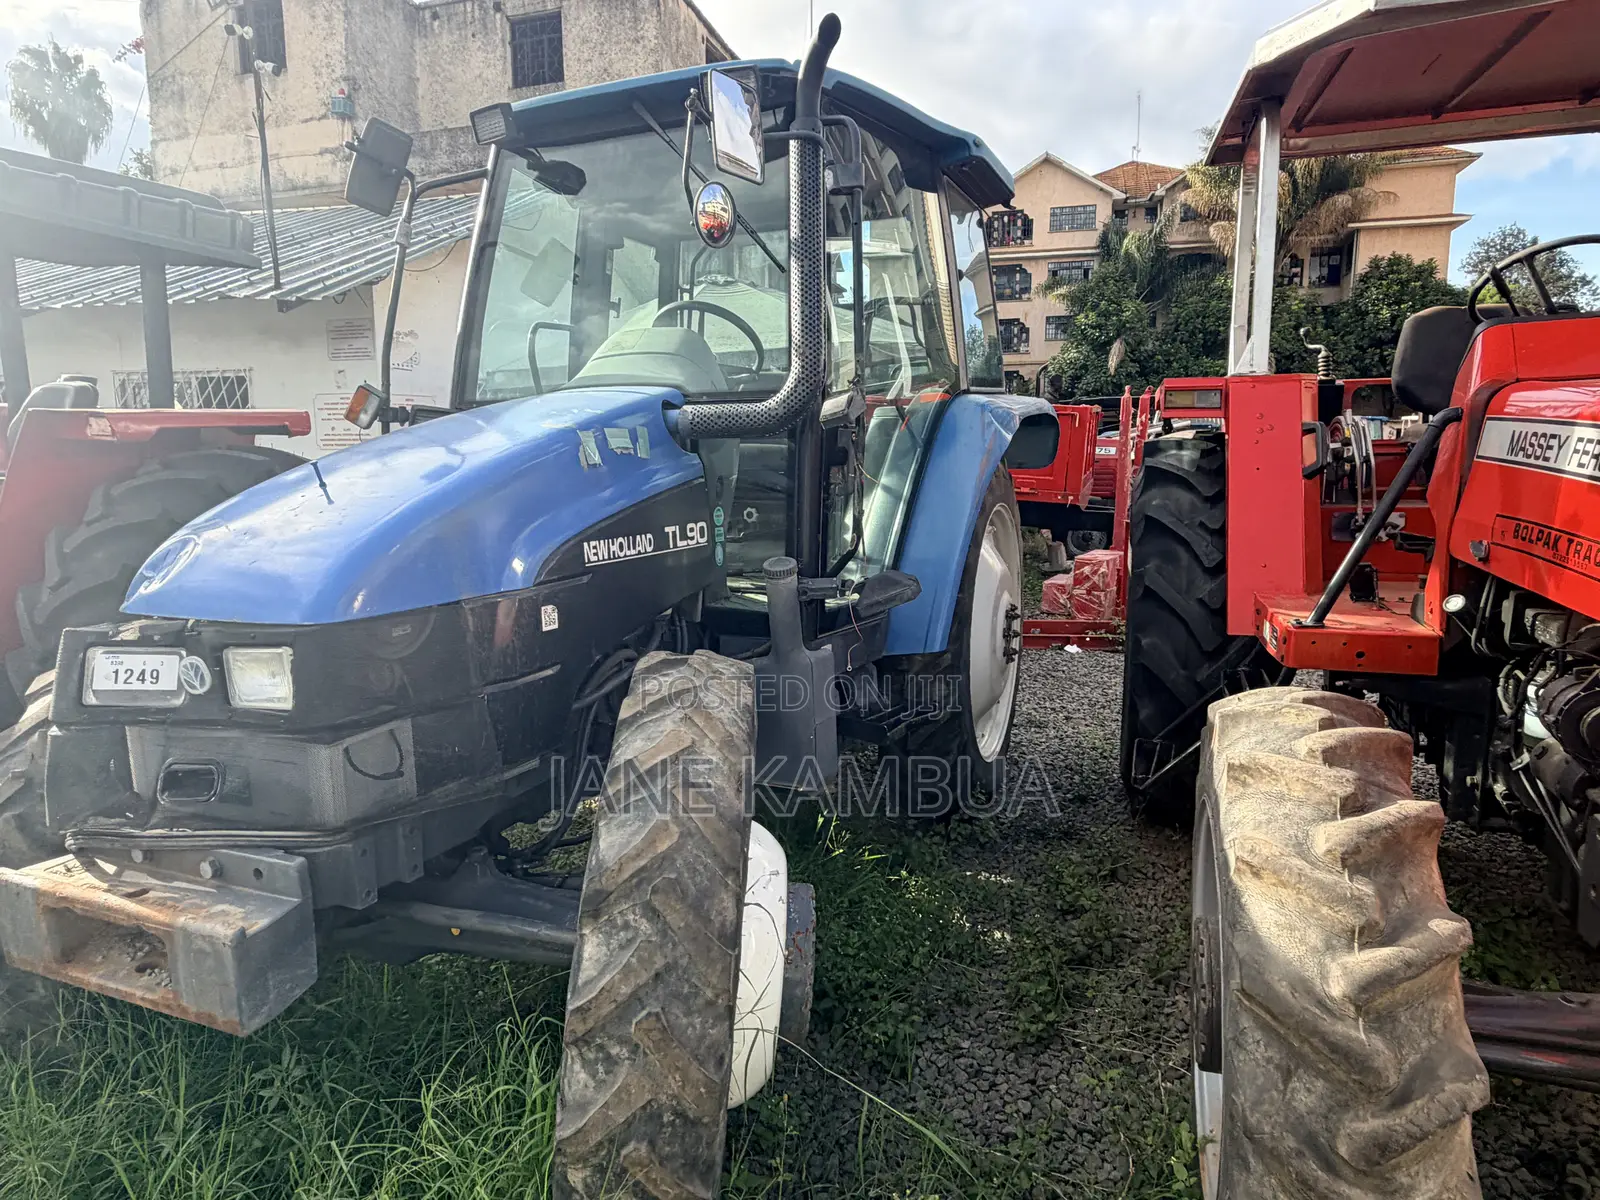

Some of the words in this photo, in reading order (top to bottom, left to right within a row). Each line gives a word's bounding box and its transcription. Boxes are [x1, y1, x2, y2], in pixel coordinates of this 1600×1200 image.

[1506, 429, 1570, 464] MASSEY
[1567, 436, 1600, 473] FER
[664, 521, 708, 549] TL90
[1513, 523, 1562, 553] BOLPAK
[112, 668, 160, 685] 1249
